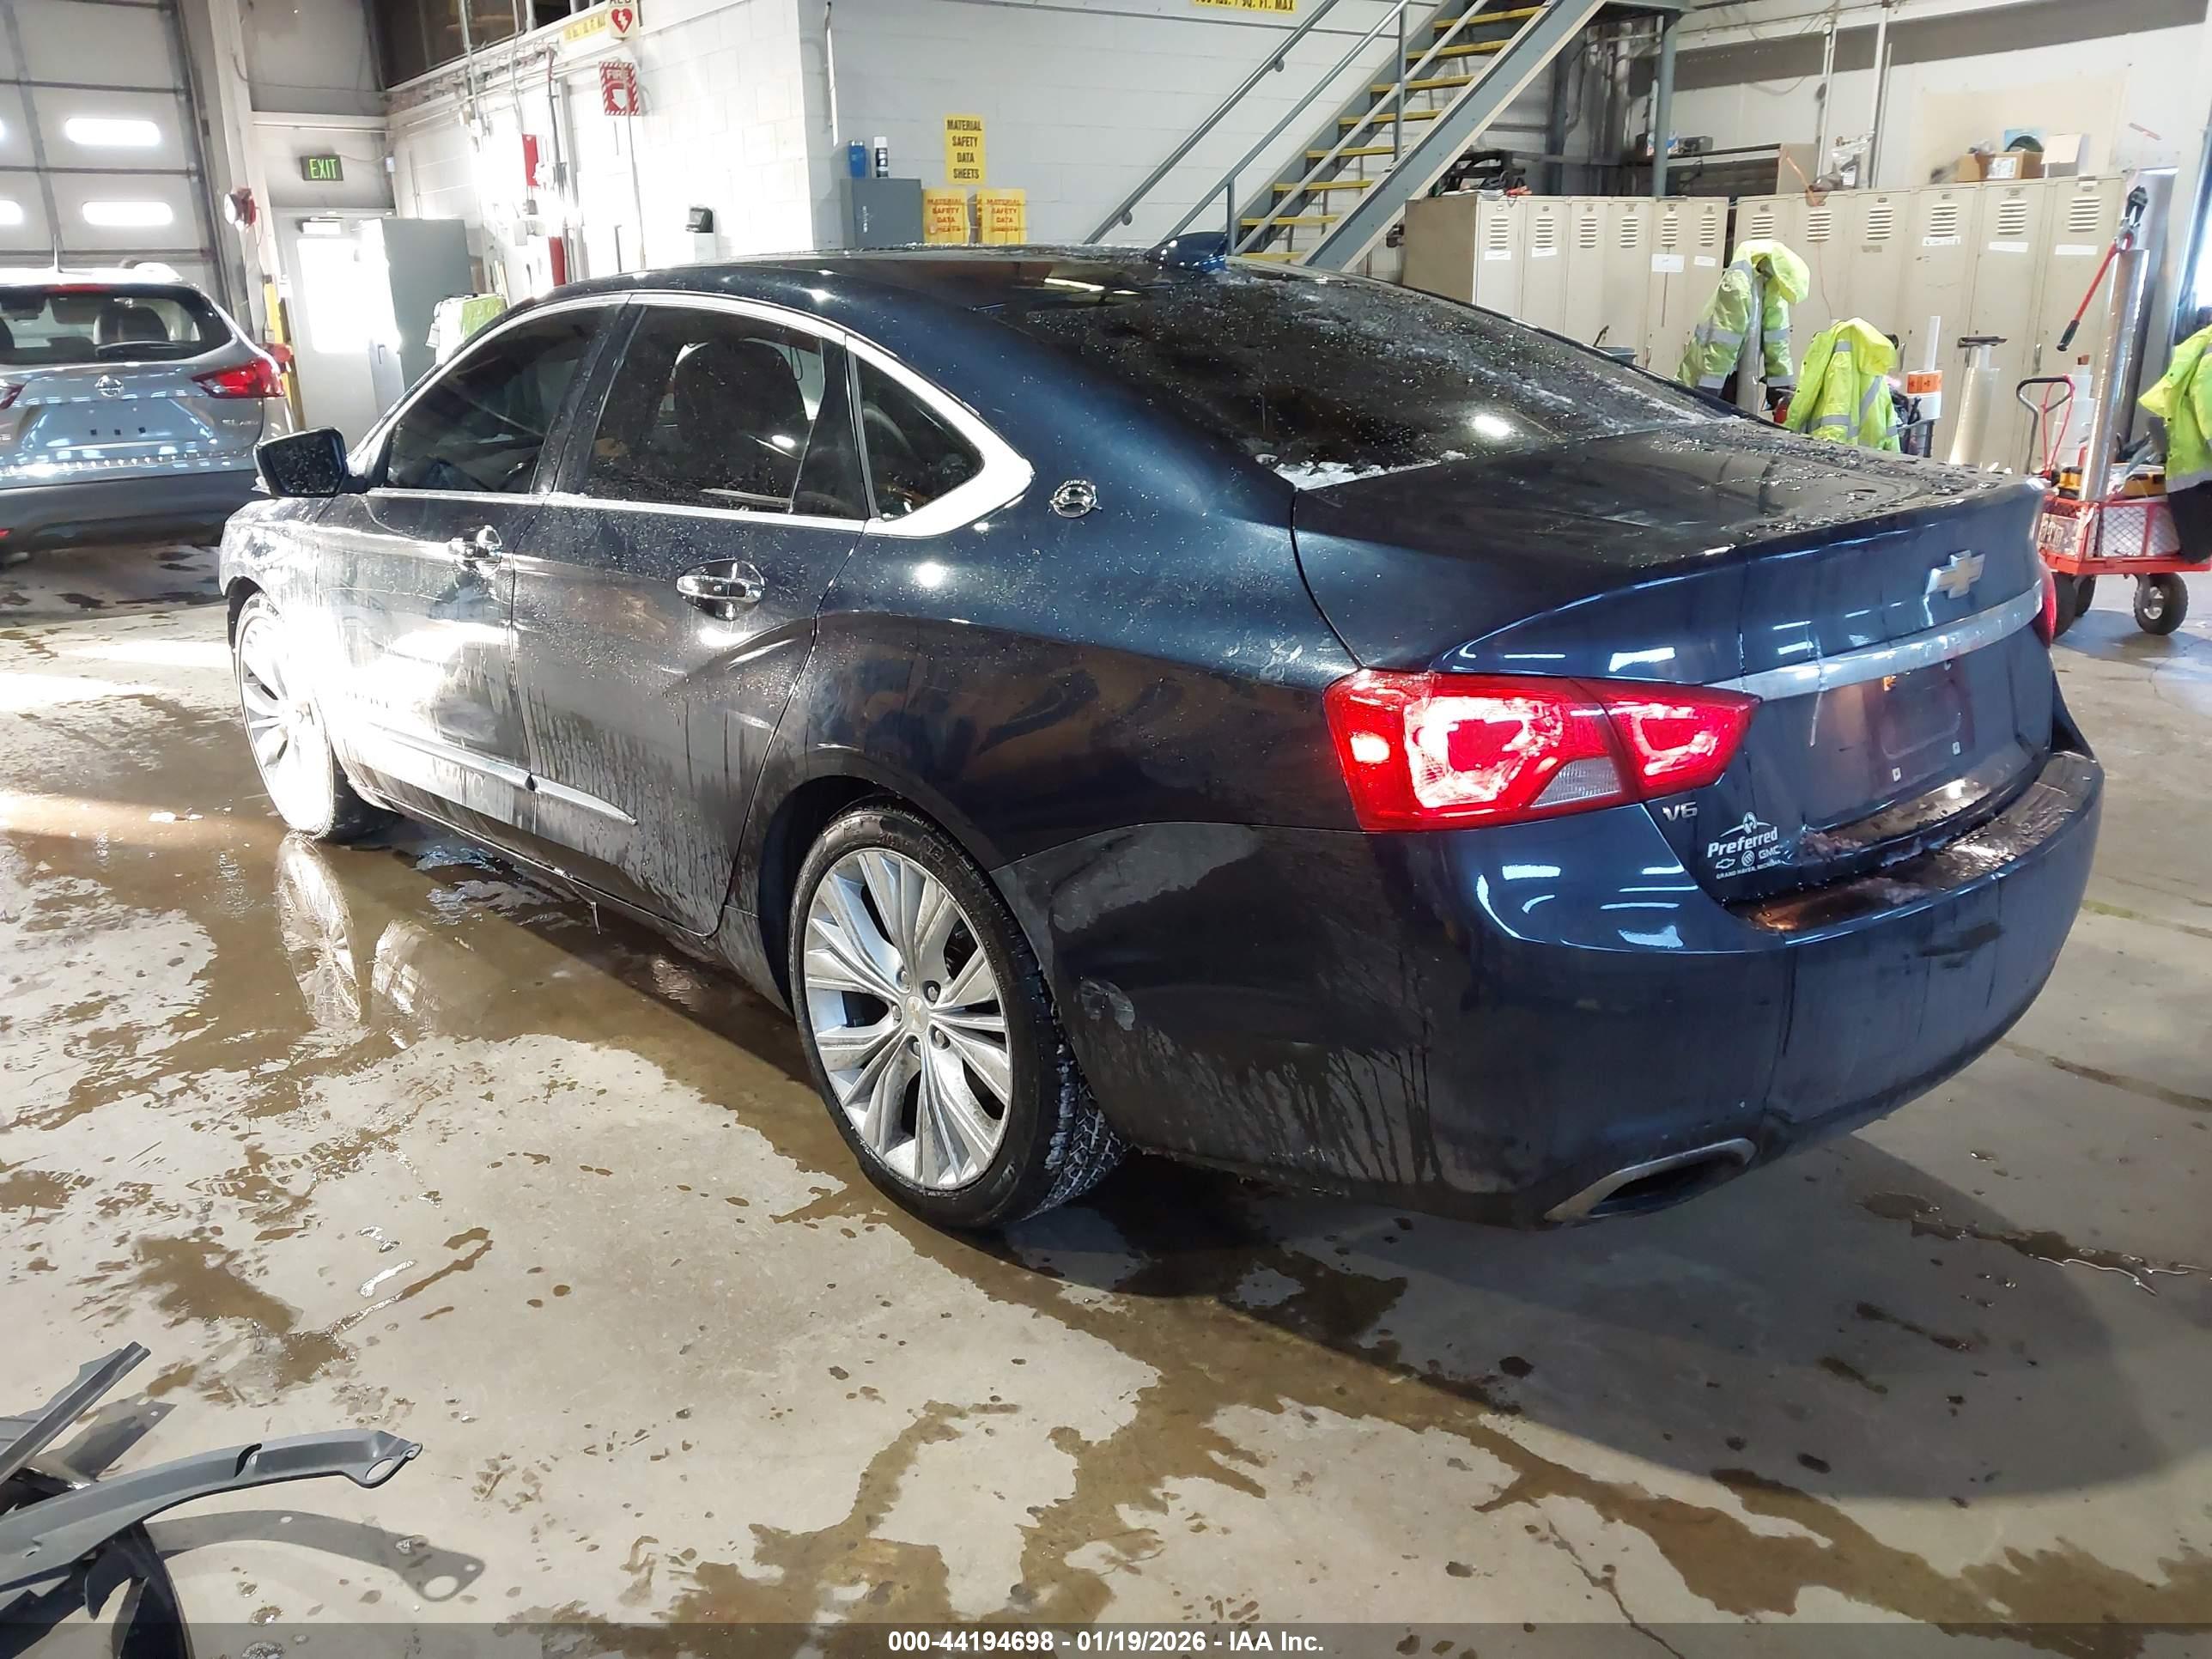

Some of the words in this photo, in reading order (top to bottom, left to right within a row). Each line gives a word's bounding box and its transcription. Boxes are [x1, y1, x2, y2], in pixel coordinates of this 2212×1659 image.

[946, 119, 981, 131] MATERIAL
[952, 136, 978, 147] SAFETY
[957, 152, 975, 163] DATA
[309, 158, 337, 179] EXIT
[953, 168, 979, 179] SHEETS
[1662, 802, 1697, 821] V6
[1707, 826, 1778, 858] Preferred
[1759, 846, 1781, 859] GMC
